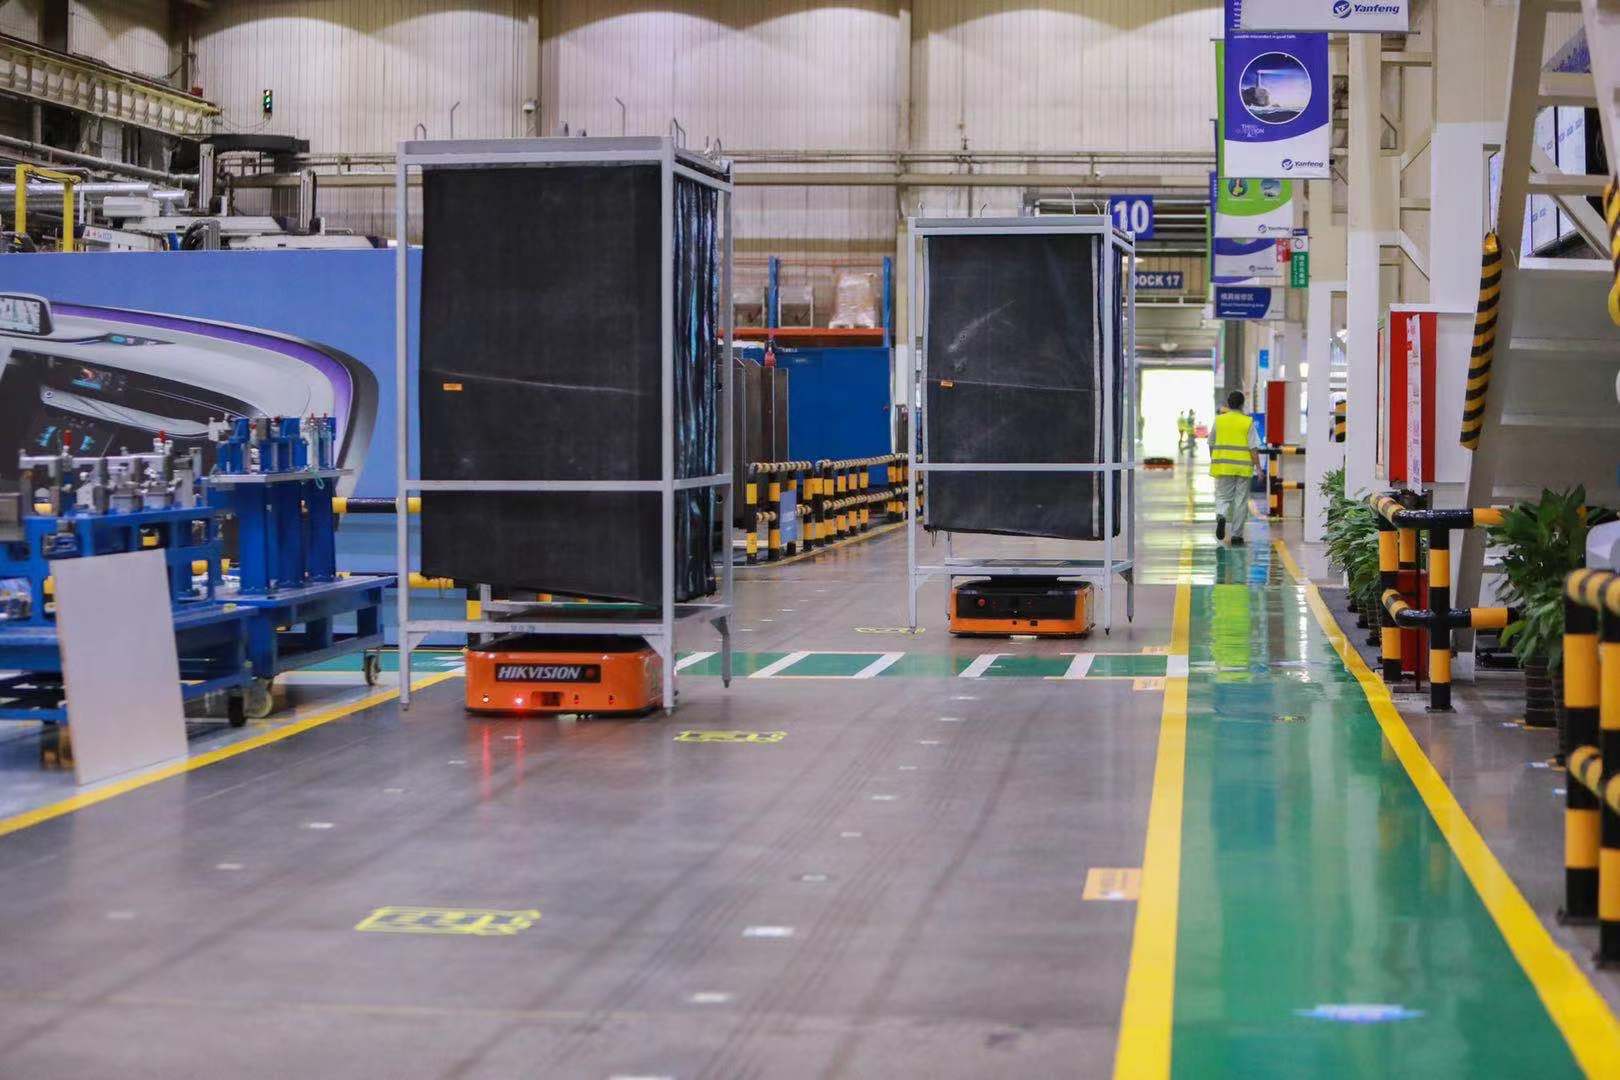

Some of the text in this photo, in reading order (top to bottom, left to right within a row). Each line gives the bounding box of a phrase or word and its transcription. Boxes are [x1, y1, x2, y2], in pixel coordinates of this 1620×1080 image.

[1354, 3, 1400, 14] Yanfeng
[1294, 160, 1324, 168] Yanfeng
[1114, 200, 1150, 234] 10
[1166, 274, 1180, 286] 17
[498, 666, 580, 680] HIKVISION
